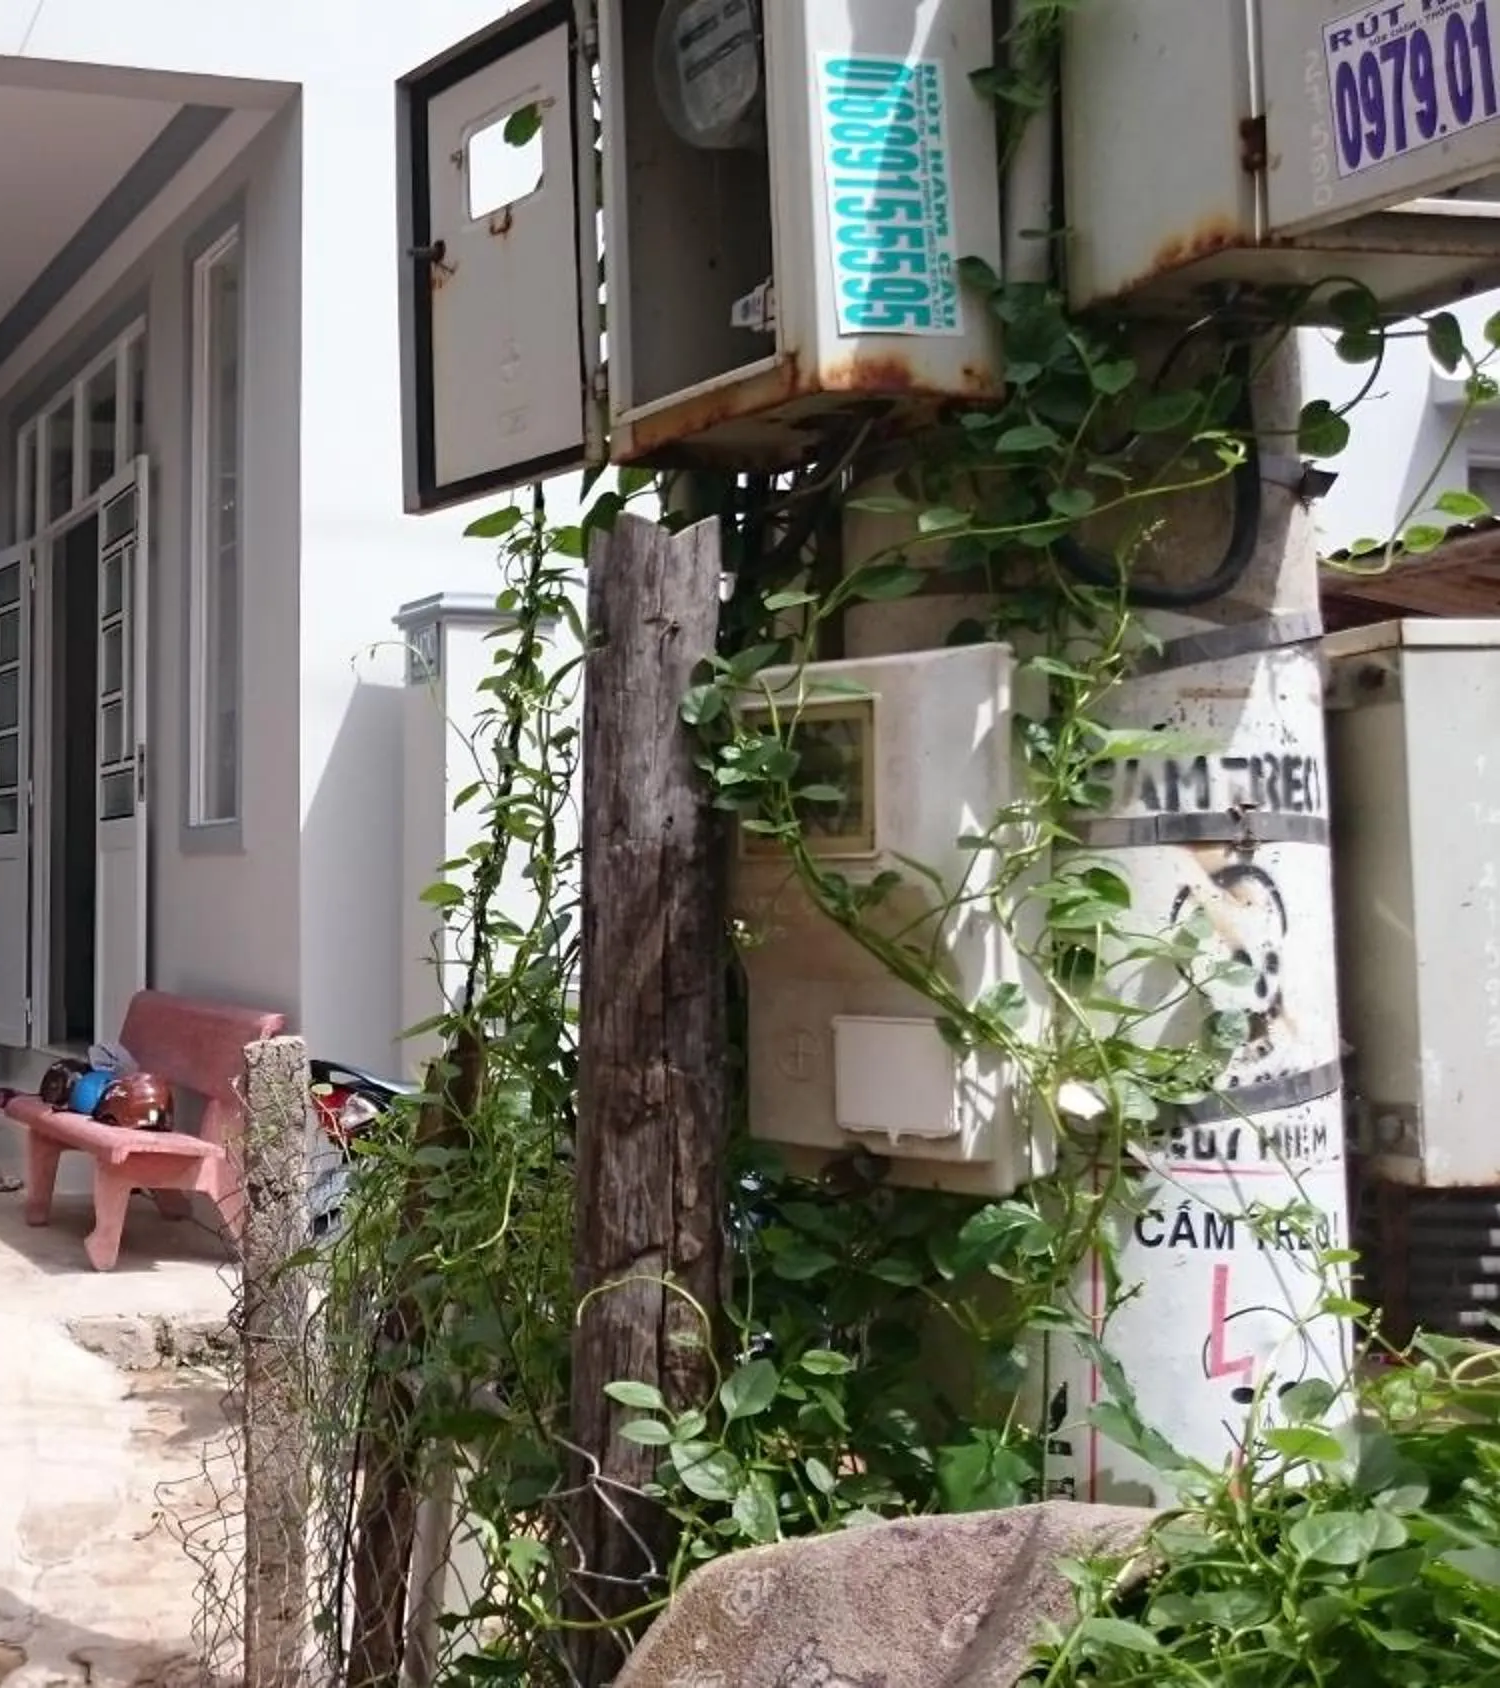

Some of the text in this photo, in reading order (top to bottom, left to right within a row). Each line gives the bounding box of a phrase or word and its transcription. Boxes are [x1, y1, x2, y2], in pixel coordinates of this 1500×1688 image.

[1335, 0, 1498, 170] 0979.01
[824, 59, 932, 327] 01689155595
[1133, 1199, 1235, 1251] CẤM
